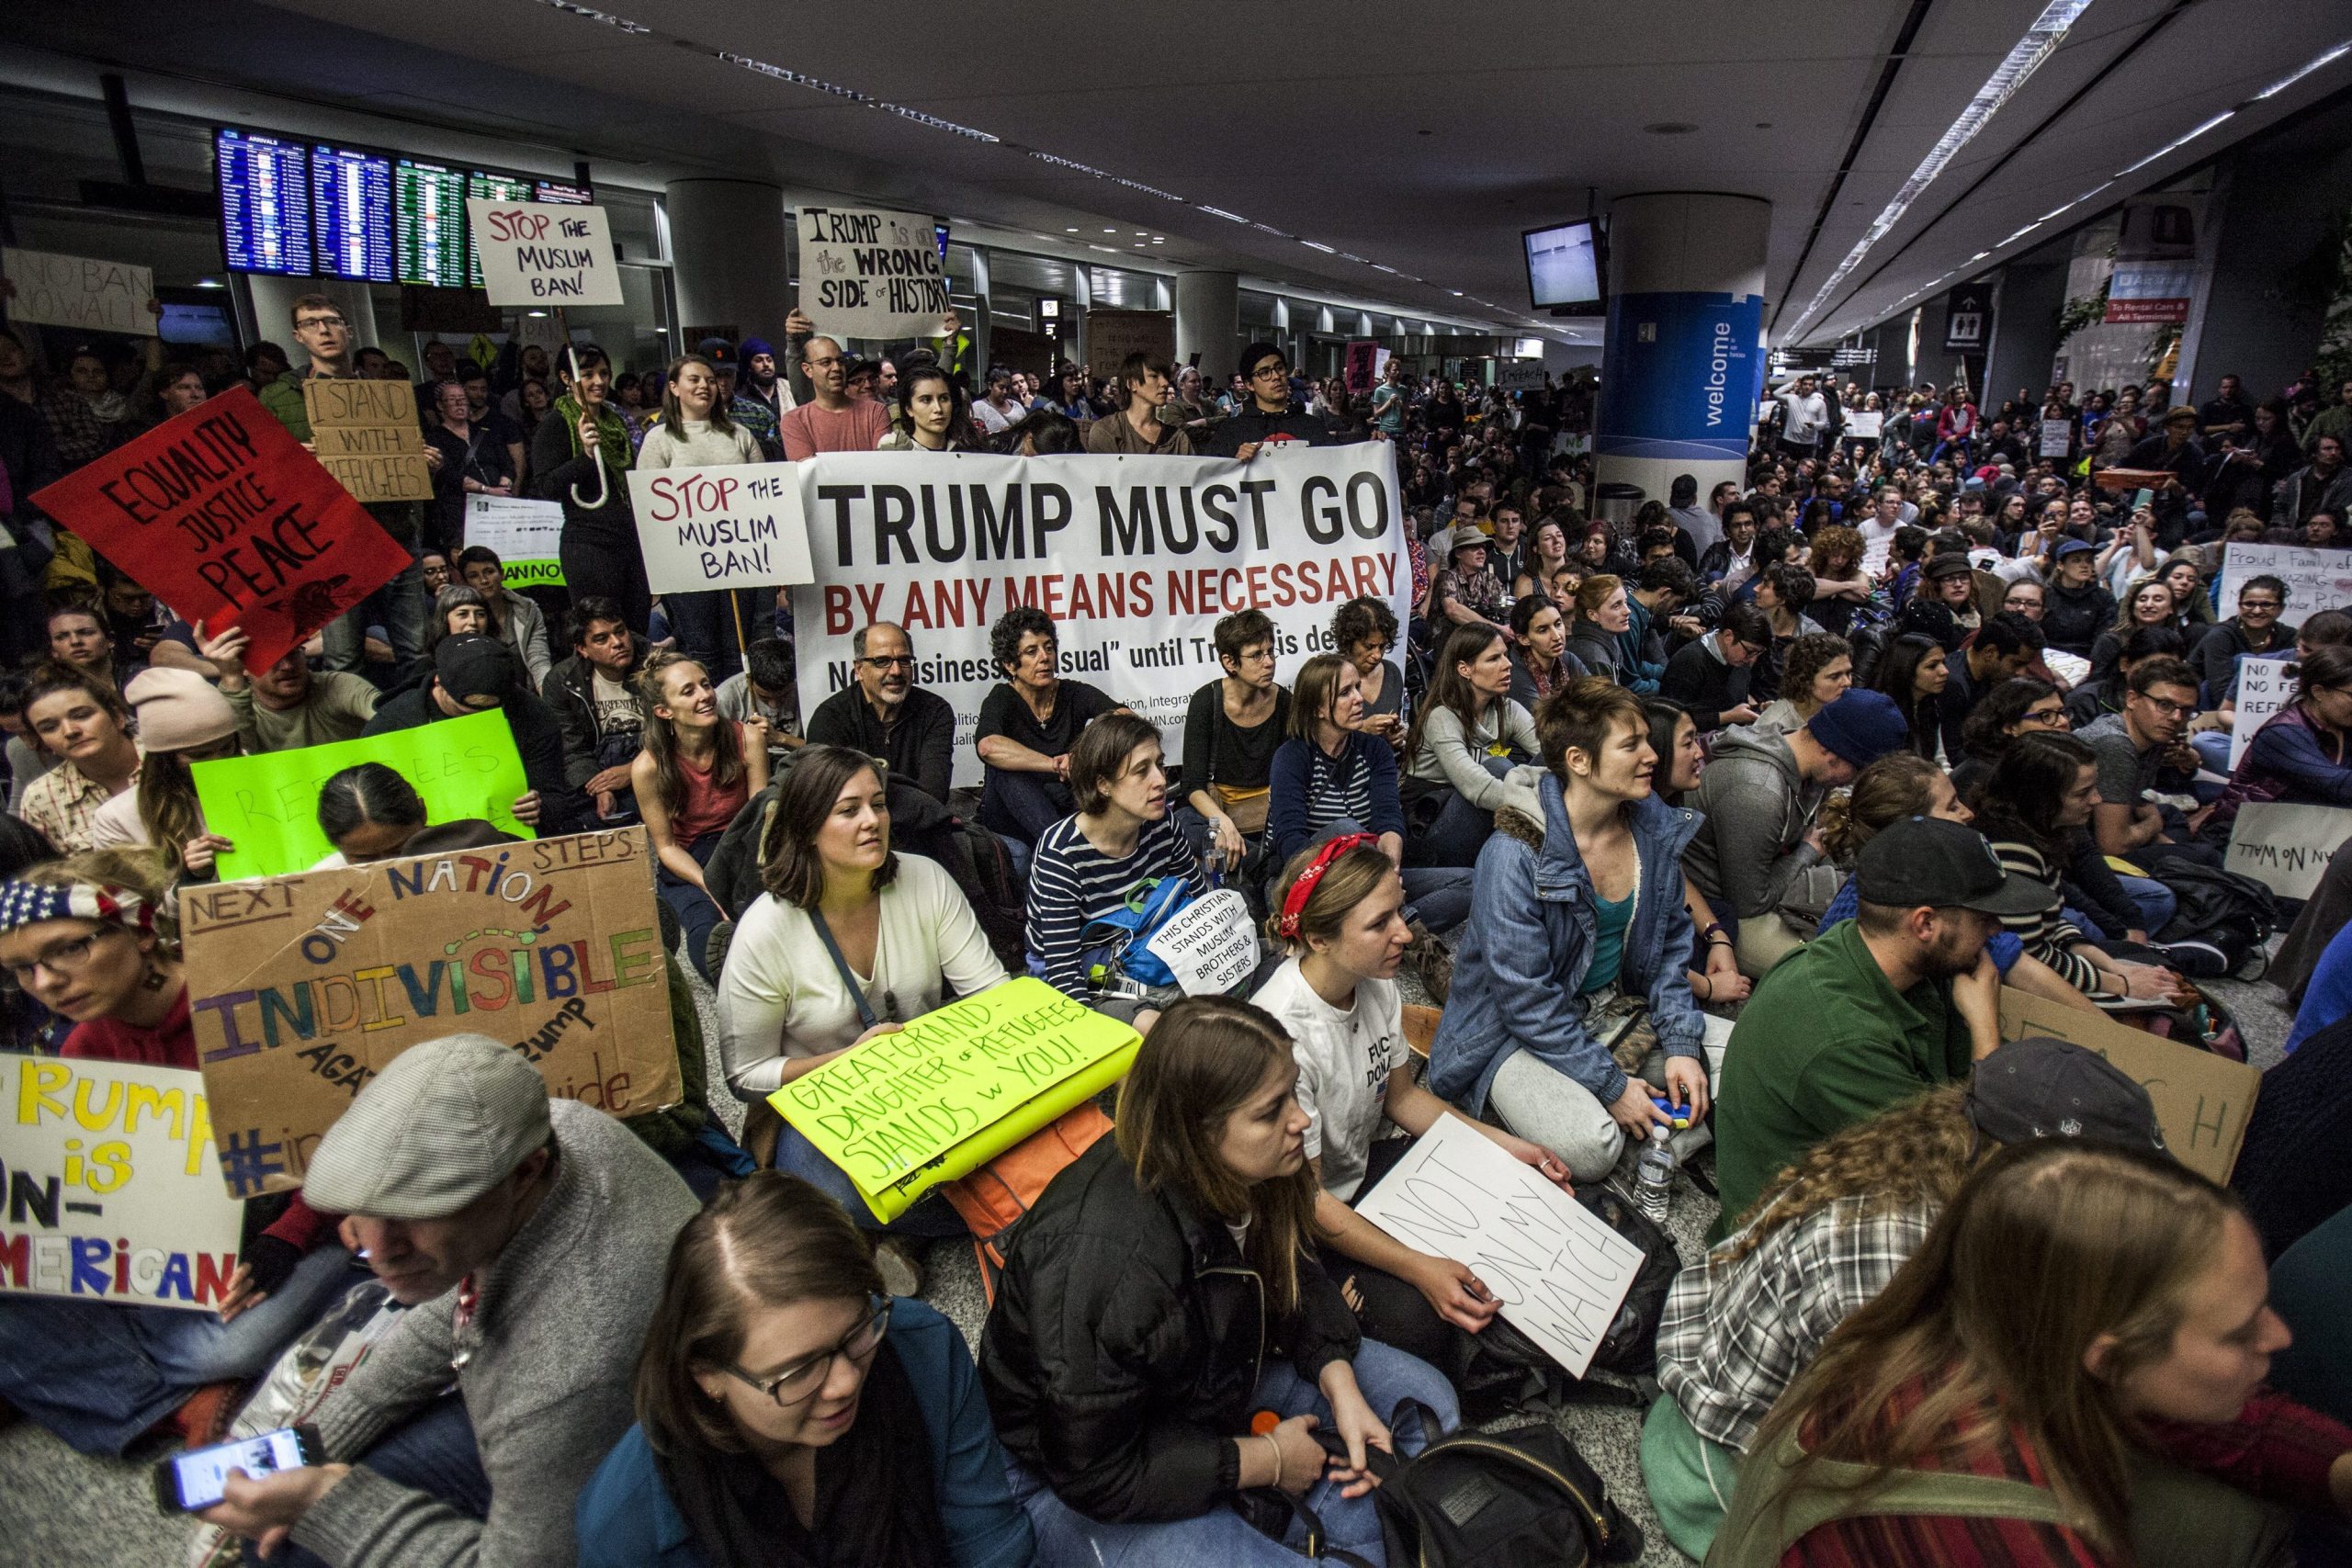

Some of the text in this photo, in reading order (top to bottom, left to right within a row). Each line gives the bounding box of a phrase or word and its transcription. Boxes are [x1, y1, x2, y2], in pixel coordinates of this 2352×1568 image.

[249, 135, 278, 146] ARRIVALS
[487, 209, 593, 243] STOP THE
[802, 208, 882, 244] TRUMP
[889, 220, 910, 246] is
[82, 260, 153, 299] BAN
[516, 245, 594, 273] MUSLIM
[817, 248, 940, 276] the WRONG
[530, 270, 584, 298] BAN!
[818, 278, 869, 309] SIDE
[888, 277, 952, 313] HISTORY
[1705, 321, 1730, 427] welcome
[306, 382, 408, 424] I STAND
[338, 428, 402, 452] WITH
[98, 411, 257, 525] EQUALITY
[176, 471, 275, 553] JUSTICE
[650, 473, 783, 522] STOP THE
[678, 514, 778, 547] MUSLIM
[817, 470, 1389, 568] TRUMP MUST GO
[197, 502, 335, 612] PEACE
[700, 542, 772, 580] BAN!
[2229, 547, 2277, 567] Proud
[2289, 550, 2331, 573] Family
[824, 552, 1397, 636] BY ANY MEANS NECESSARY
[1129, 637, 1184, 669] until
[2245, 664, 2269, 677] NO
[2245, 681, 2269, 693] NO
[2236, 842, 2278, 868] WALL
[189, 878, 305, 925] NEXT
[1156, 891, 1232, 945] THIS CHRISTIAN
[301, 887, 376, 965] ONE
[1171, 904, 1238, 953] STANDS WITH
[1196, 925, 1237, 958] MUSLIM
[1195, 934, 1252, 980] BROTHERS &
[1216, 954, 1252, 987] SISTERS
[817, 1055, 975, 1141] DAUGHTER
[969, 998, 1088, 1061] REFUGEES
[842, 1096, 980, 1180] STANDS
[997, 1034, 1089, 1087] YOU!
[64, 1138, 134, 1194] is
[1379, 1138, 1499, 1264] NOT
[1467, 1178, 1575, 1306] ON MY
[1522, 1214, 1636, 1357] WATCH
